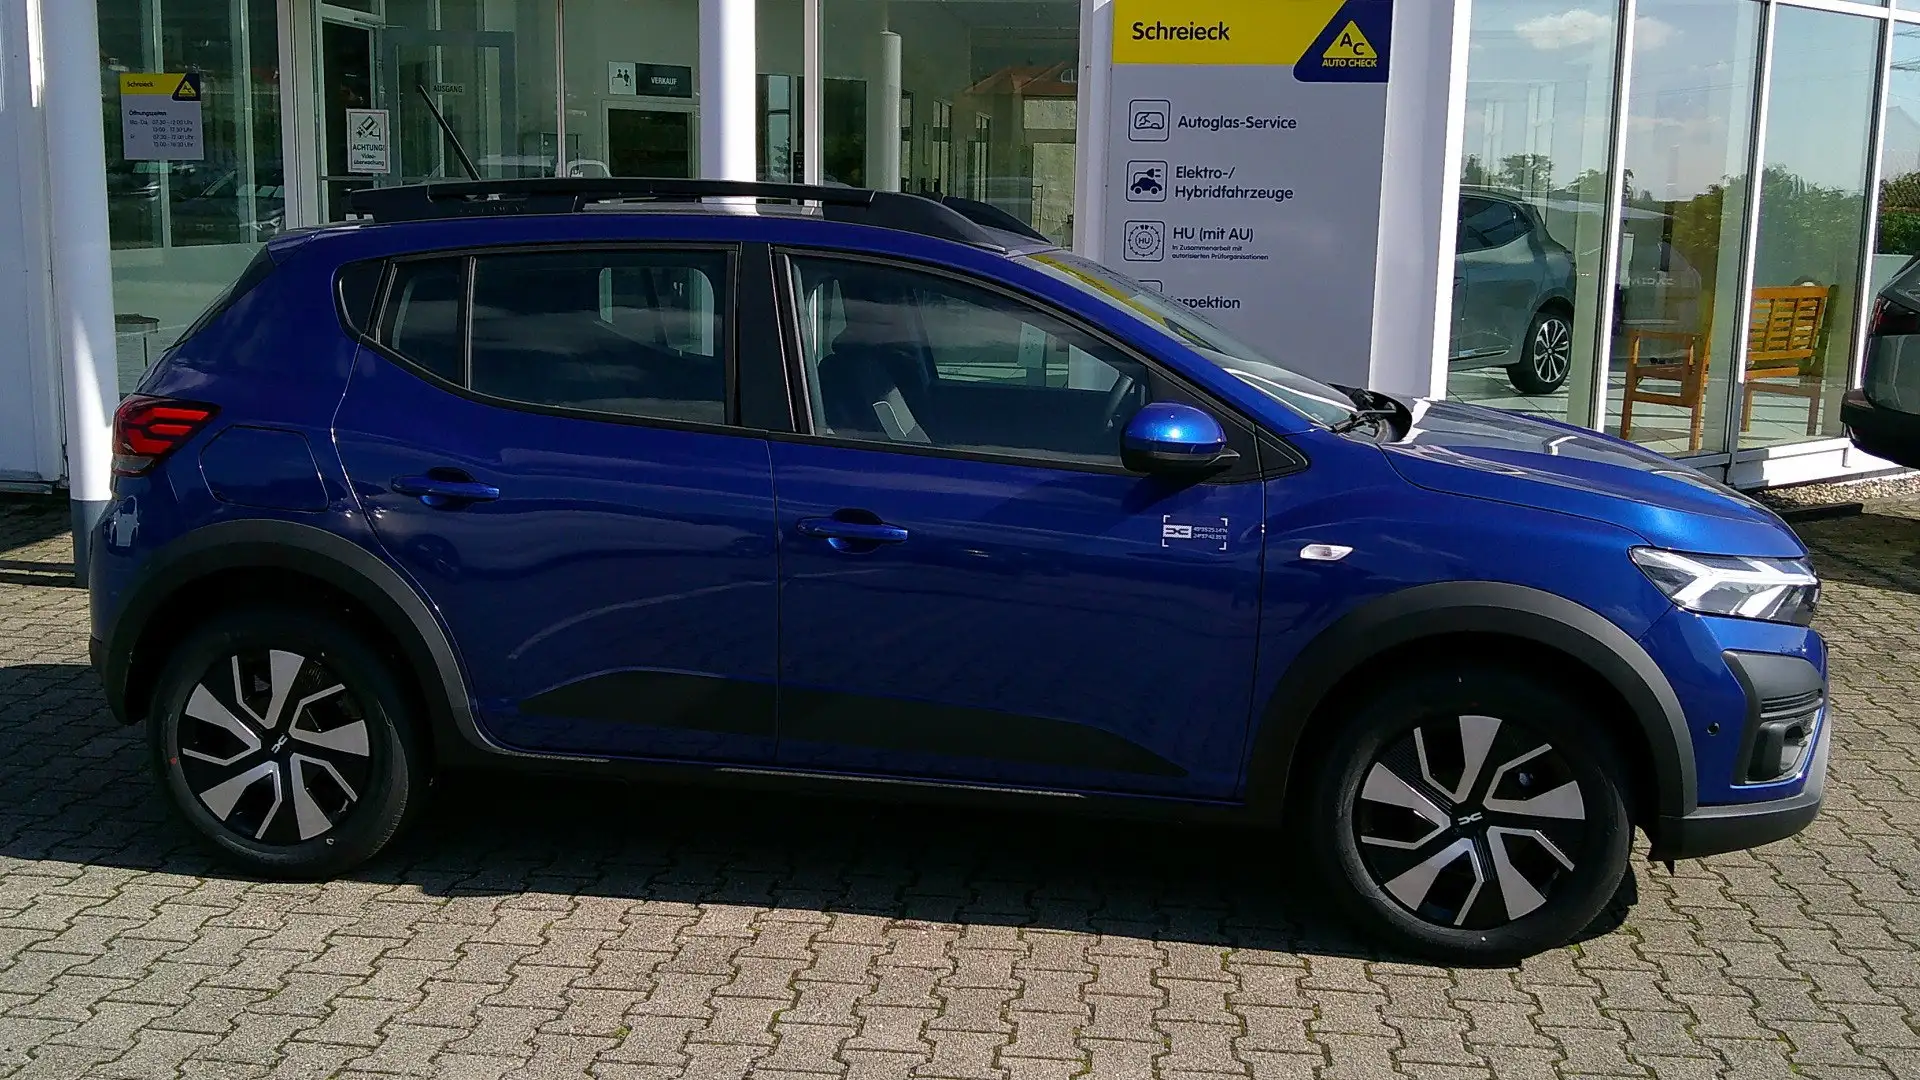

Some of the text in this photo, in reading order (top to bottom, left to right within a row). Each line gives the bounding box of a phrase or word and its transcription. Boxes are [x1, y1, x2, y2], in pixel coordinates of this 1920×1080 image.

[1132, 21, 1230, 41] Schreieck
[1321, 58, 1377, 68] AUTO CHECK
[651, 77, 677, 85] VERKAUF
[434, 85, 463, 93] AUSGANG
[1177, 115, 1297, 131] Autoglas-Service
[1175, 166, 1235, 180] Elektro-/
[1174, 185, 1294, 202] Hybridfahrzeuge
[1138, 236, 1150, 245] HU
[1173, 227, 1254, 242] HU (mit AU)
[1171, 295, 1240, 309] spektion
